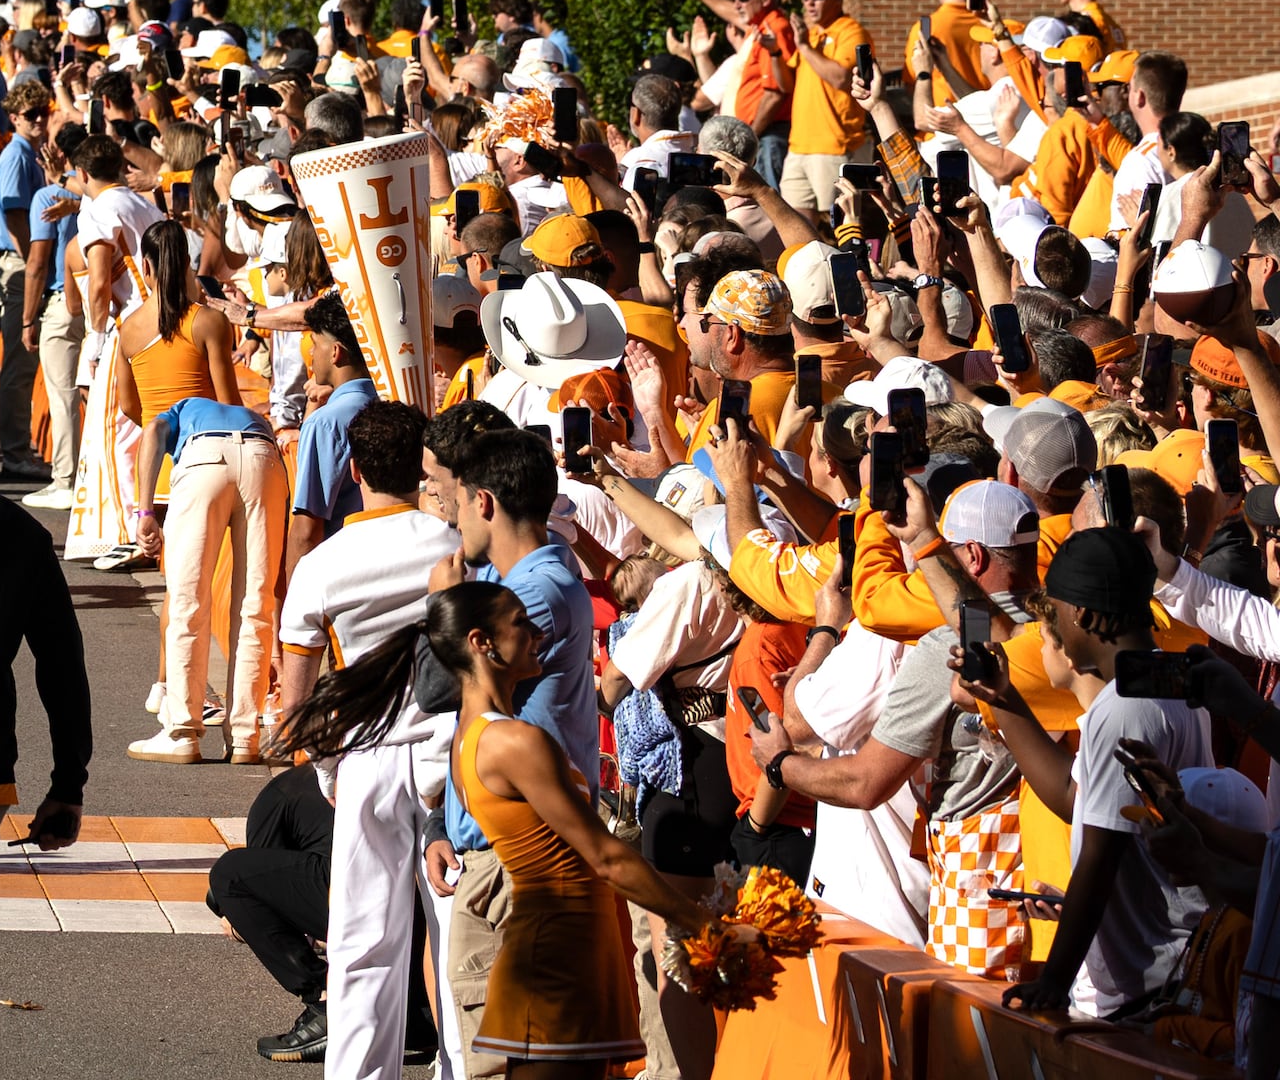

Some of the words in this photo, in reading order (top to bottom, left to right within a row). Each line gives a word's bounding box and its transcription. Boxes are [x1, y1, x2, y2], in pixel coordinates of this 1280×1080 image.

[359, 175, 409, 230] T
[380, 243, 403, 259] CG
[1221, 371, 1240, 383] TEAM
